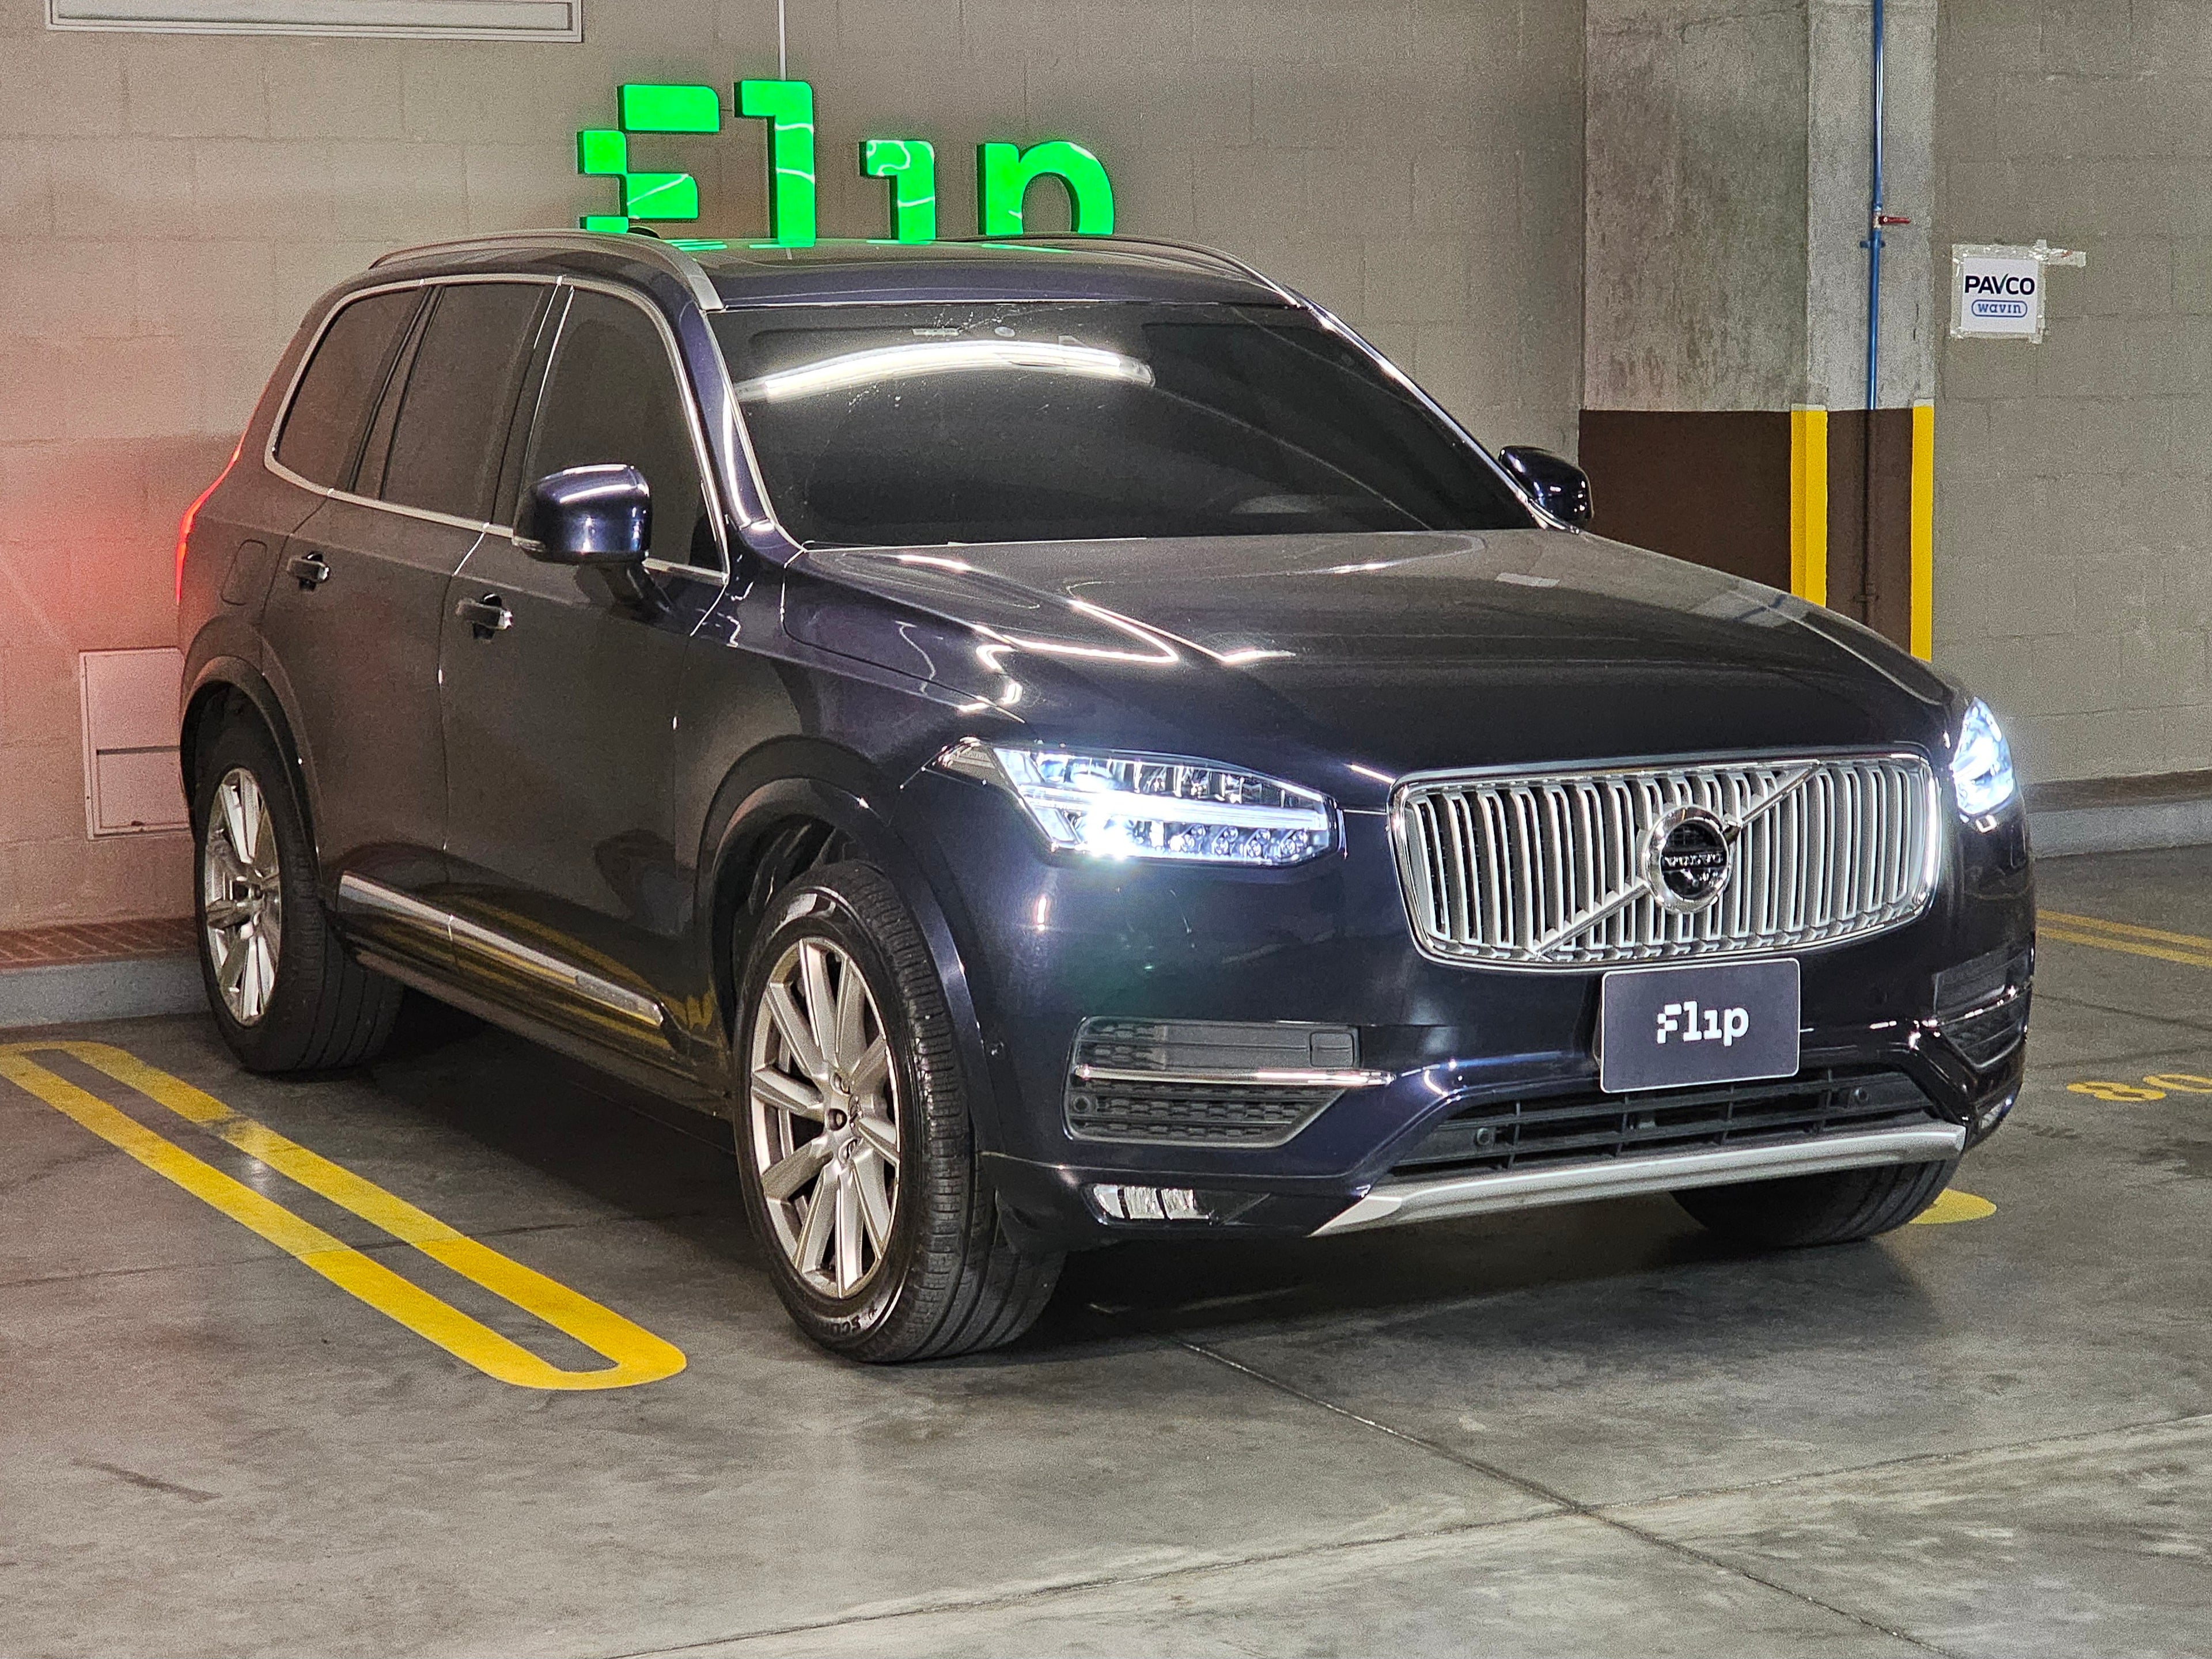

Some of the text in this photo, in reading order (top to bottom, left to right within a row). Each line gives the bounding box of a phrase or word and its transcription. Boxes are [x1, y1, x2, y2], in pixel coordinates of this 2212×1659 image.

[1964, 273, 2036, 296] PAVCO
[1977, 303, 2022, 314] wavin
[1657, 1001, 1749, 1047] Flip
